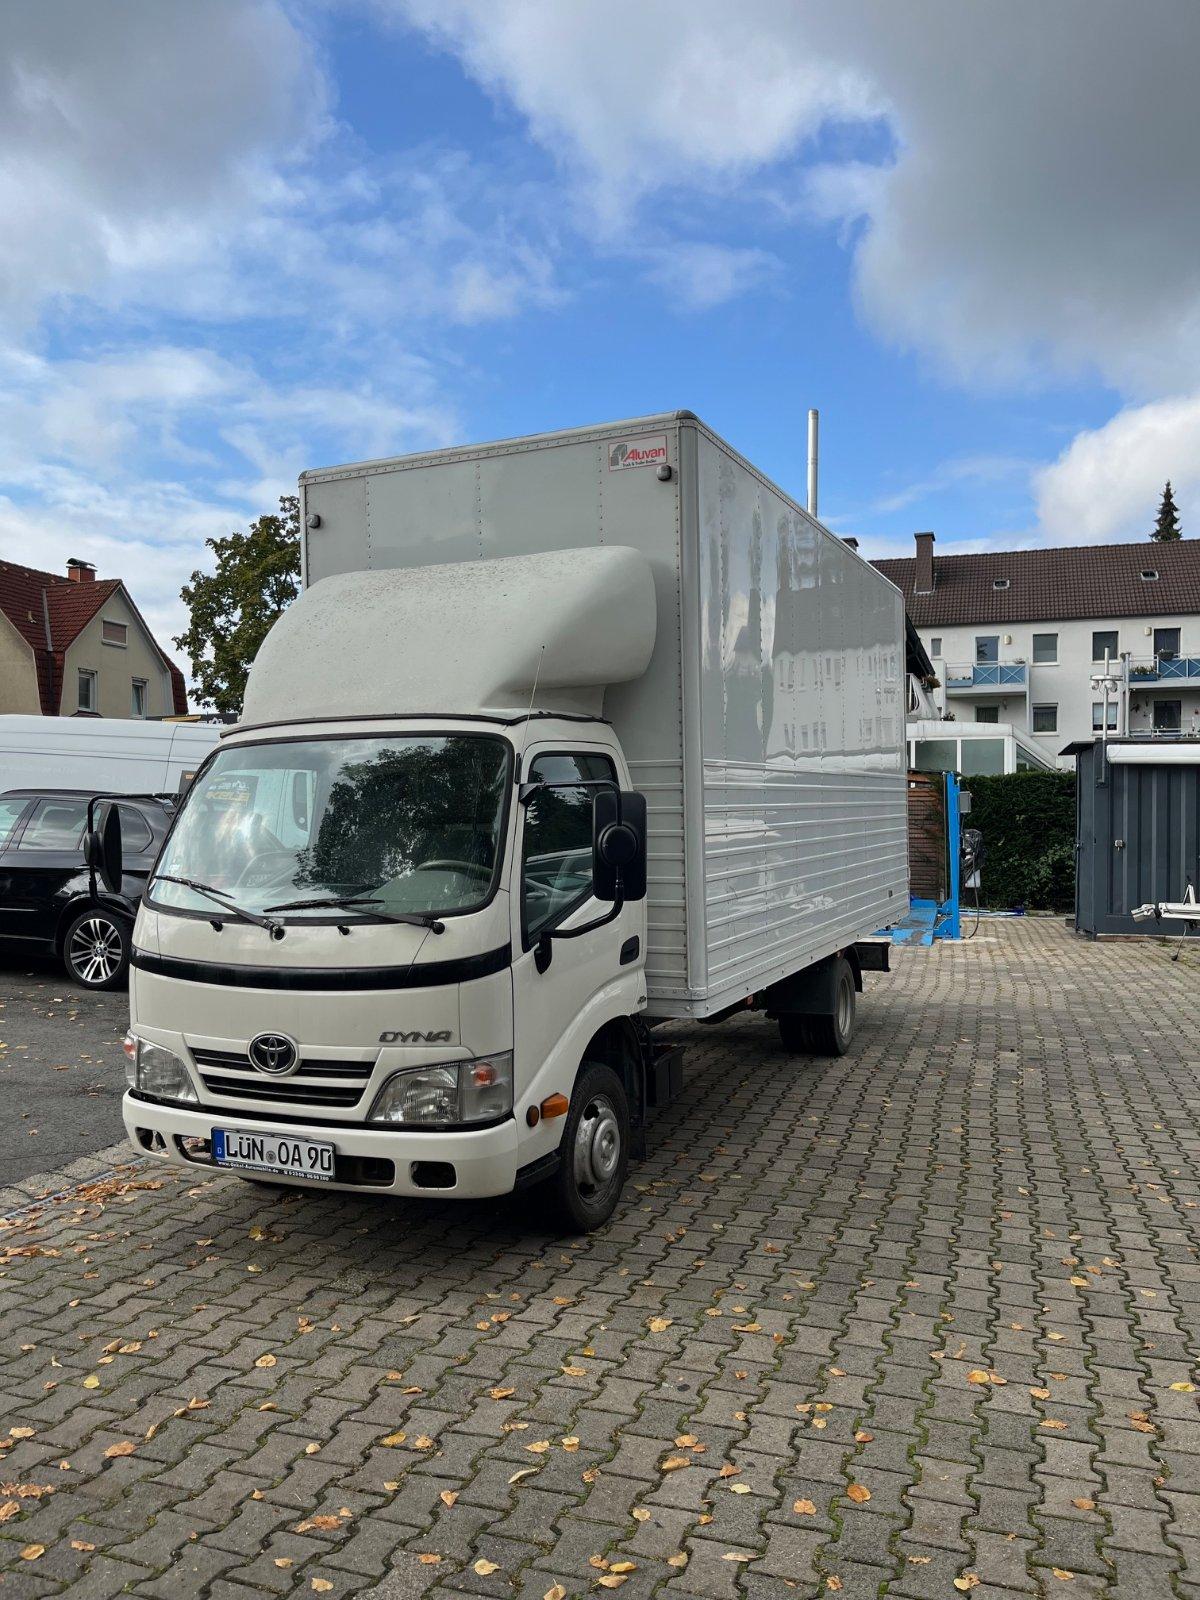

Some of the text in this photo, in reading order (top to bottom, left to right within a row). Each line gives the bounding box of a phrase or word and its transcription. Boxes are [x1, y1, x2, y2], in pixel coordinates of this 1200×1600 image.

[624, 447, 666, 462] Aluvan
[379, 1031, 452, 1043] DYNA
[226, 1135, 332, 1171] LÜN OA 90
